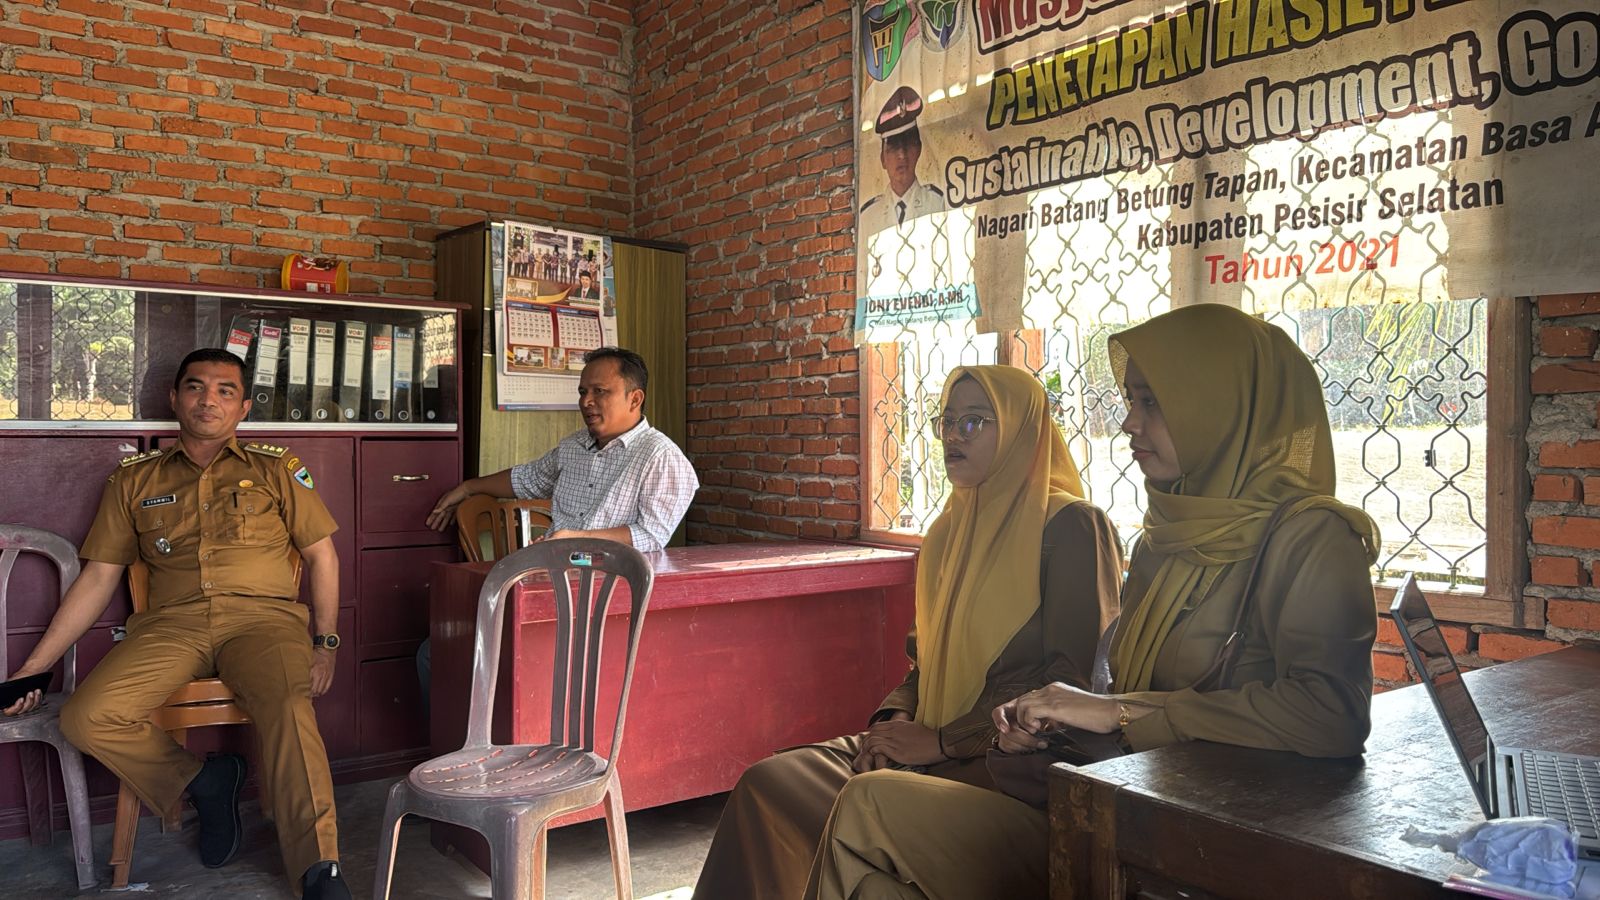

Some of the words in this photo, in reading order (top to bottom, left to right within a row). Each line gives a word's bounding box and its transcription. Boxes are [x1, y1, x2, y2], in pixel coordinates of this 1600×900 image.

[946, 122, 1152, 206] Sustainable,
[1148, 35, 1497, 162] Development,
[988, 6, 1206, 128] PENETAPAN
[977, 207, 1033, 239] Nagari
[1040, 197, 1109, 229] Batang
[1117, 181, 1194, 216] Betung
[1204, 167, 1287, 202] Tapan,
[1297, 132, 1468, 186] Kecamatan
[1481, 115, 1572, 156] Basa
[1137, 212, 1263, 250] Kabupaten
[1274, 192, 1365, 233] Pesisir
[1378, 177, 1505, 221] Selatan
[1204, 252, 1303, 285] Tahun
[1314, 235, 1400, 275] 2021
